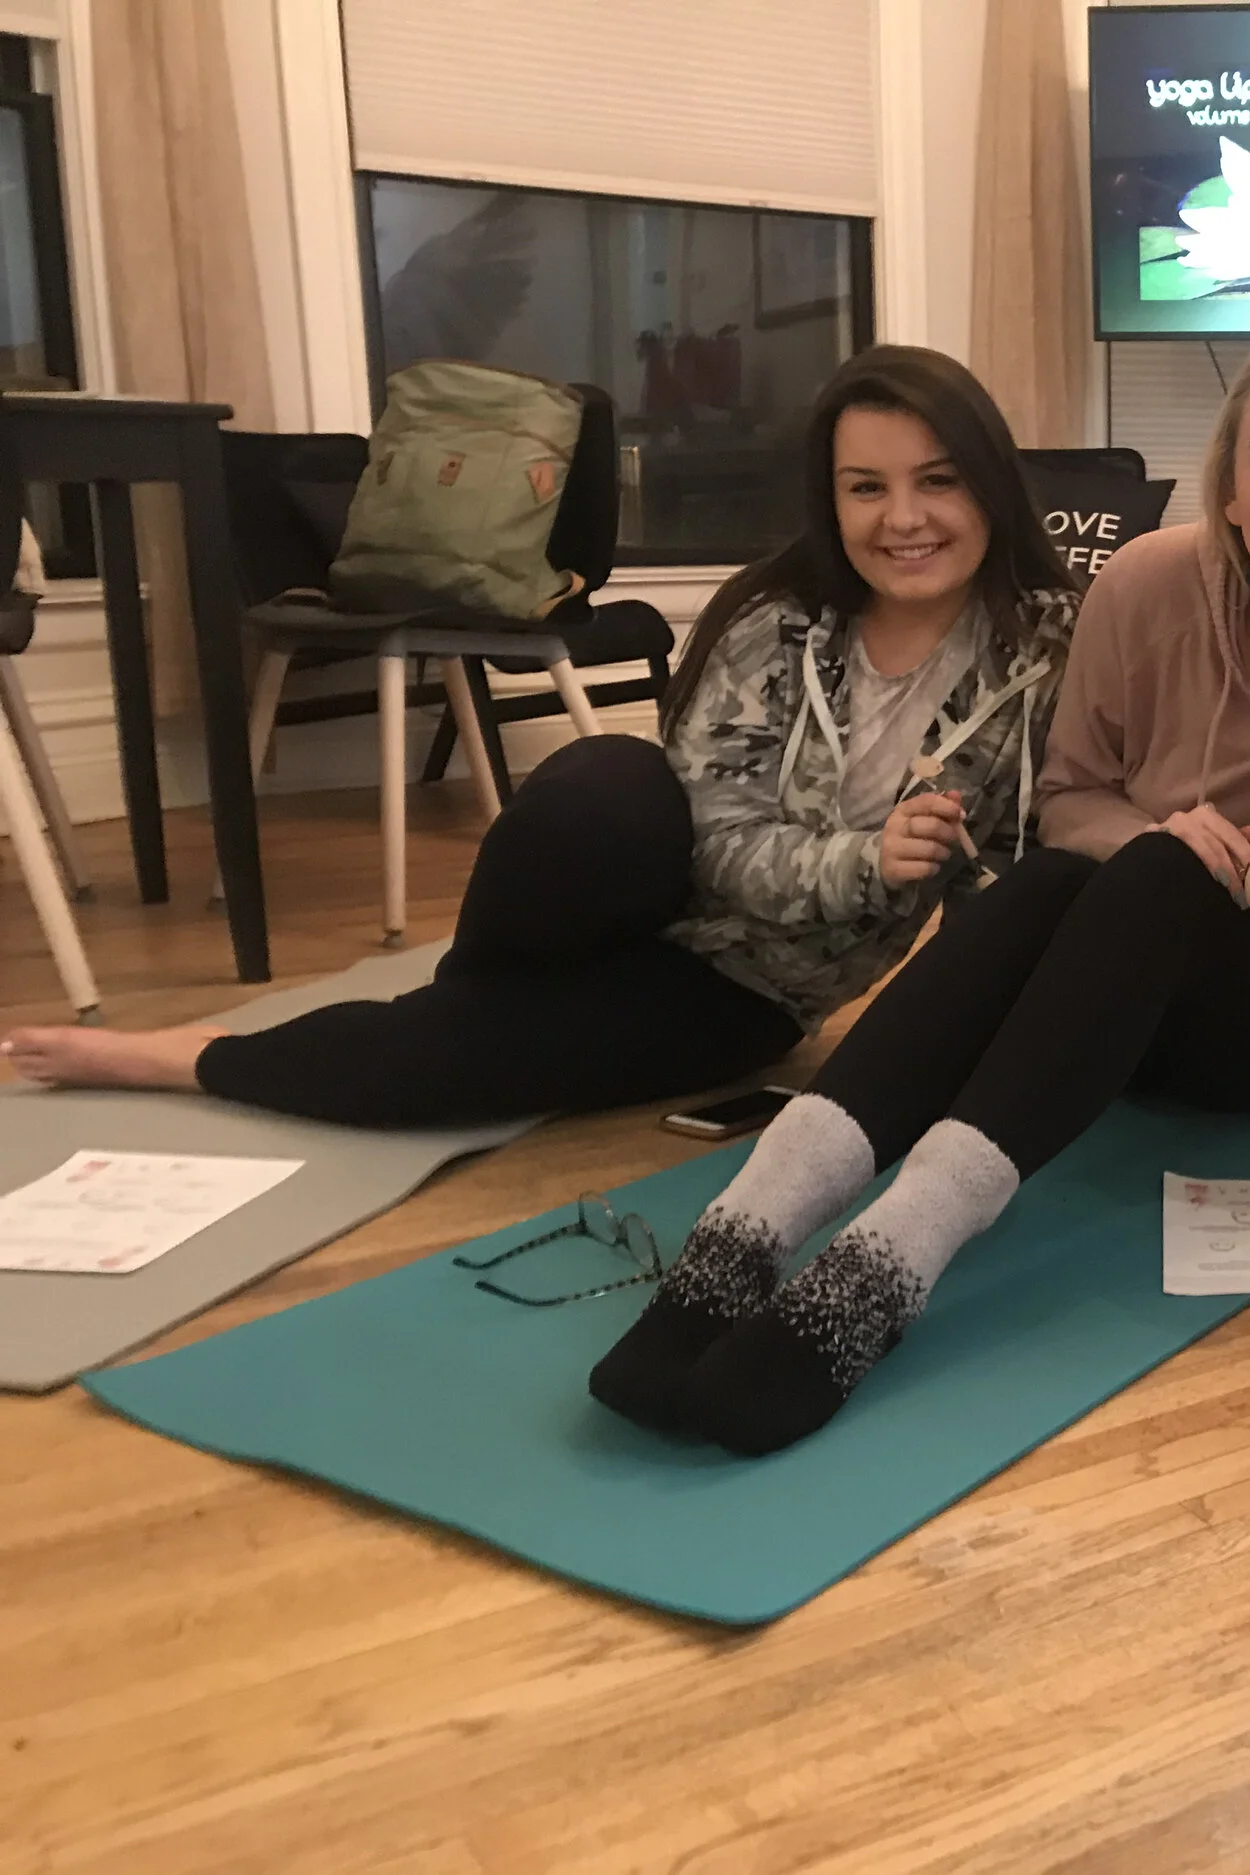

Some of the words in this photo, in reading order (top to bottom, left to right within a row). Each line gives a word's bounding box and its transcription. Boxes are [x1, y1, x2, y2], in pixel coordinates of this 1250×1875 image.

[1146, 79, 1215, 107] yoga
[1186, 105, 1250, 126] volume
[1042, 510, 1122, 540] OVE
